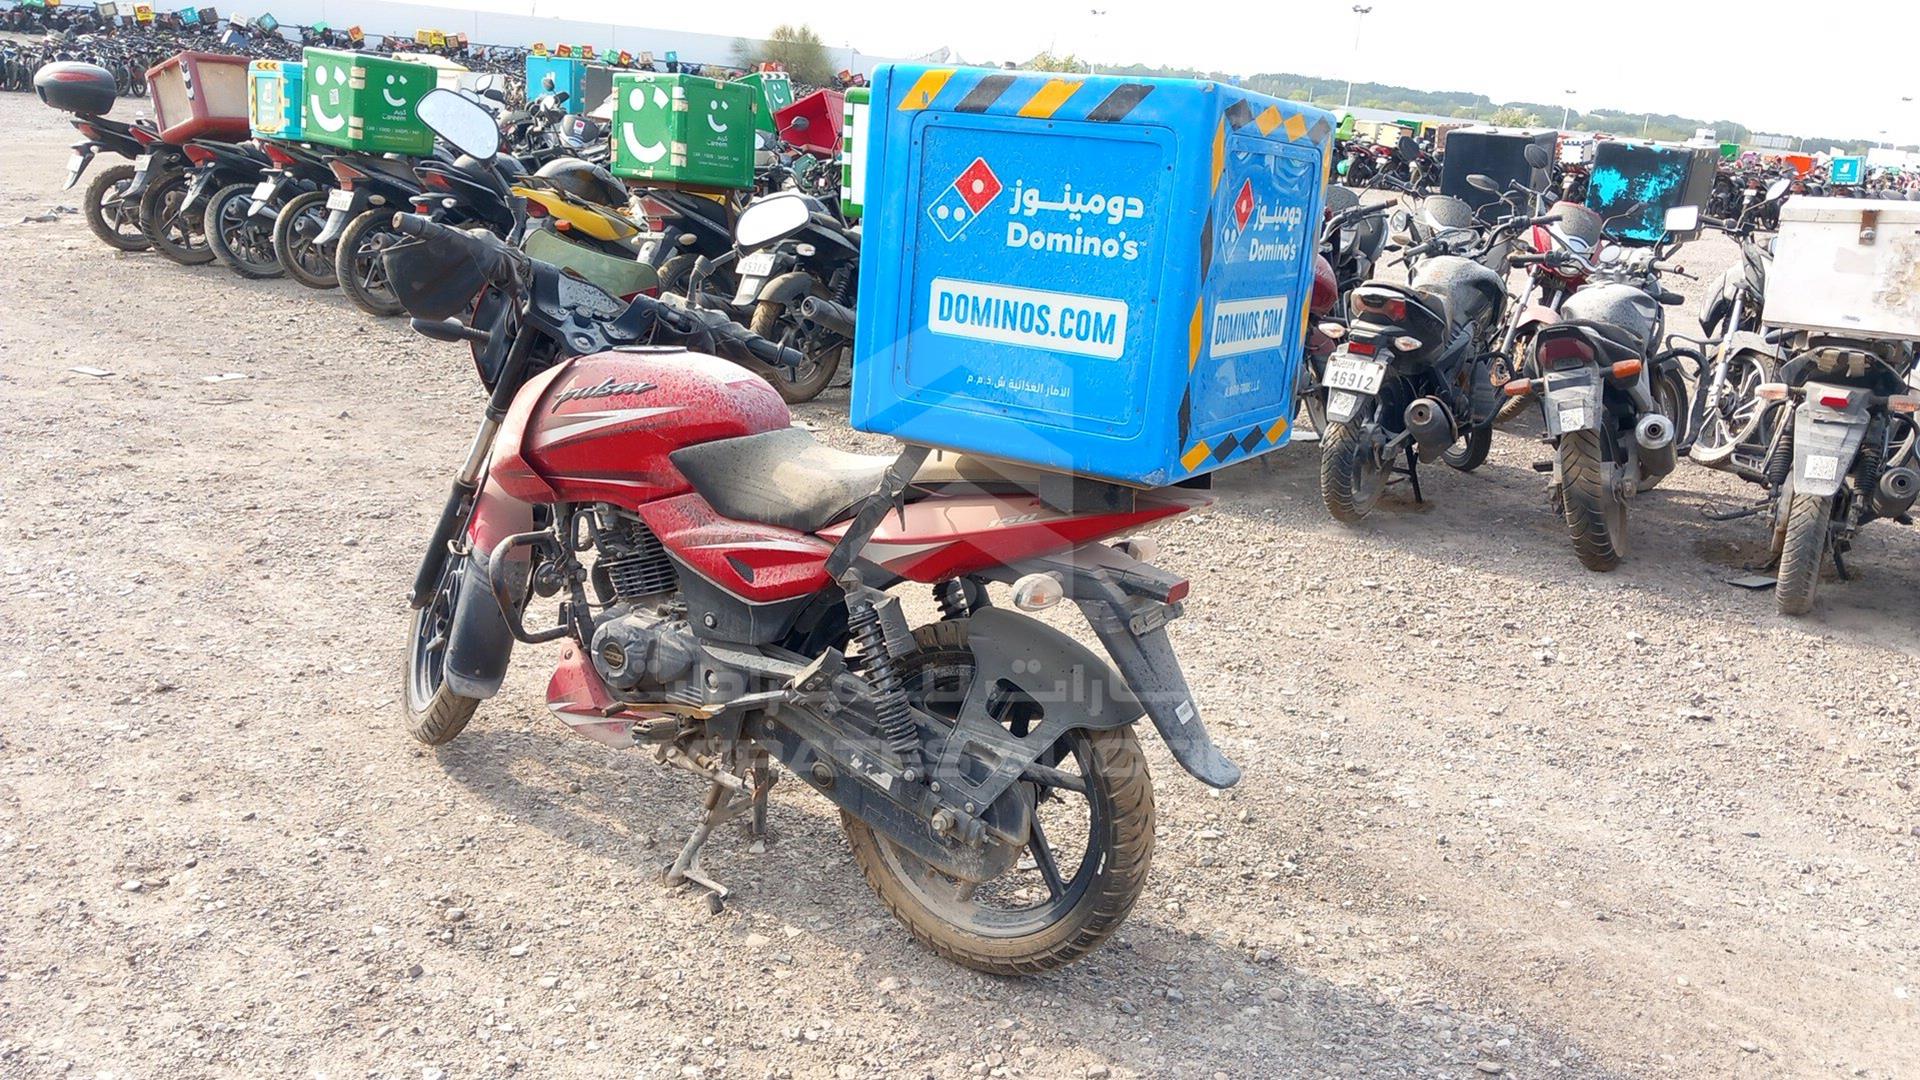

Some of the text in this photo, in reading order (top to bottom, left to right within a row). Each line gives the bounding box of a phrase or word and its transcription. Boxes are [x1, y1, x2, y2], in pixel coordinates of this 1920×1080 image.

[1006, 221, 1139, 260] Domino's
[1249, 236, 1297, 262] Domino's
[938, 291, 1117, 345] DOMINOS.COM
[1215, 308, 1283, 345] DOMINOS.COM
[1330, 370, 1374, 391] 46912
